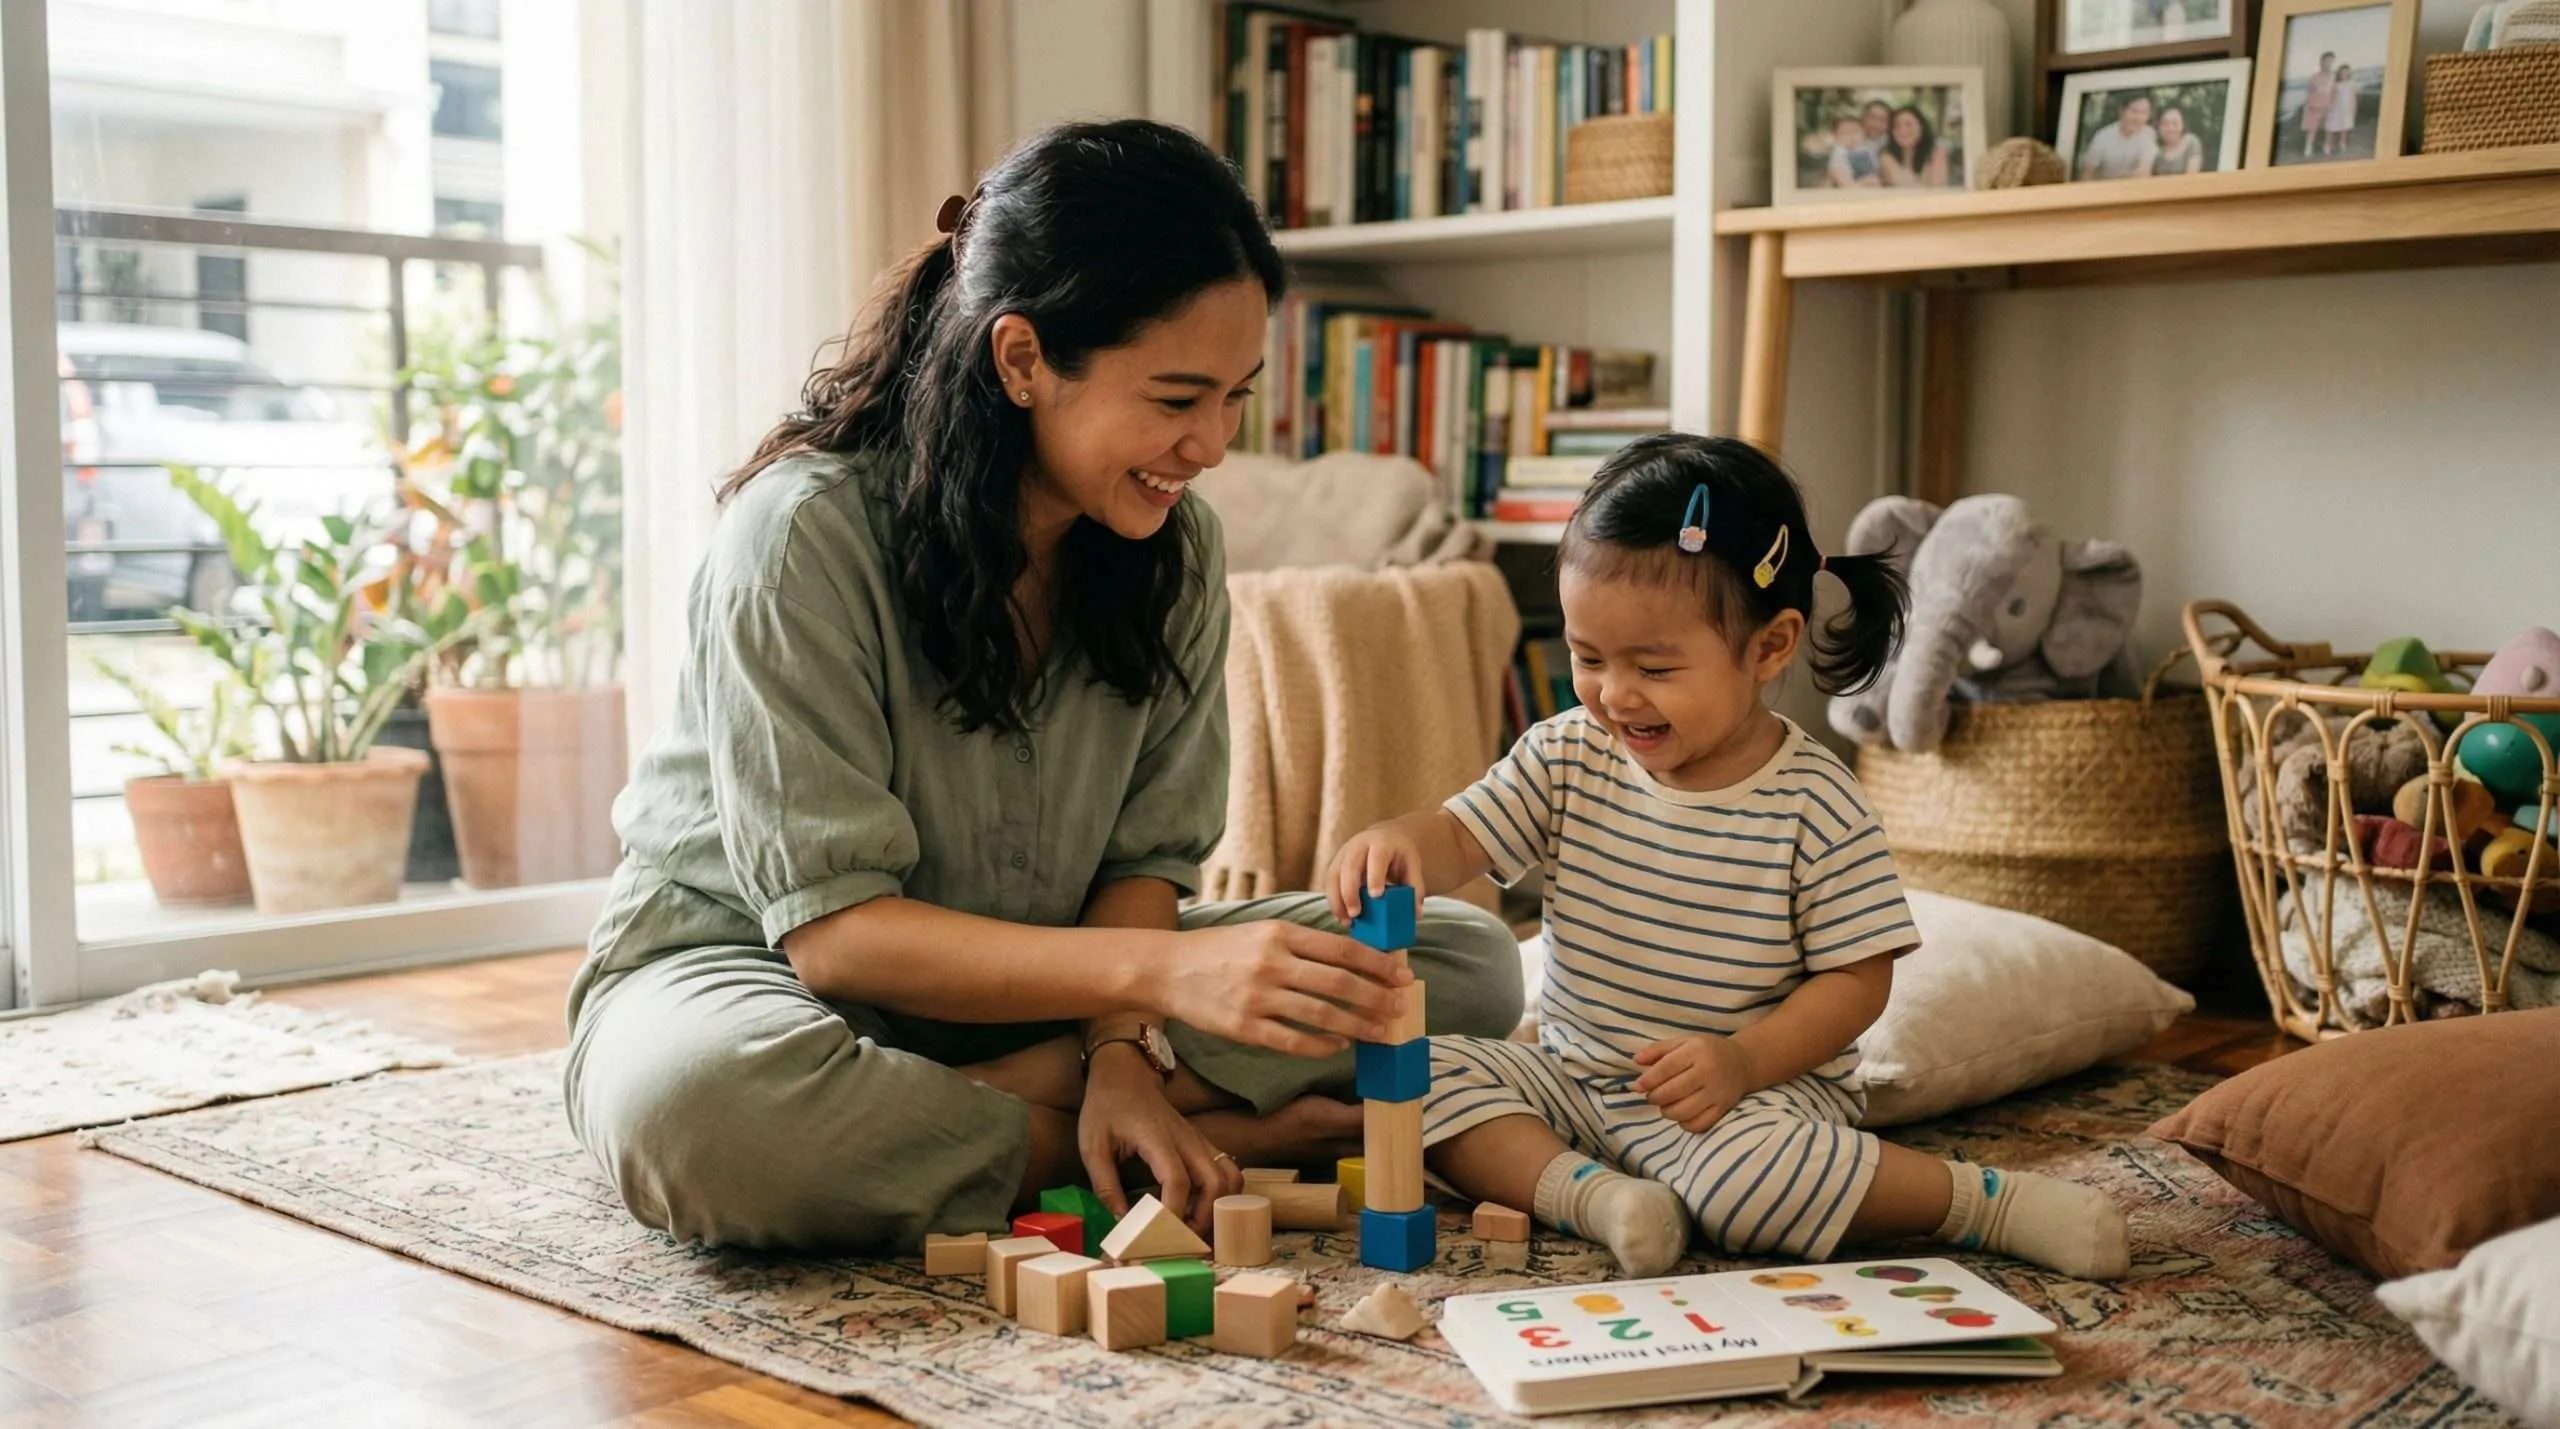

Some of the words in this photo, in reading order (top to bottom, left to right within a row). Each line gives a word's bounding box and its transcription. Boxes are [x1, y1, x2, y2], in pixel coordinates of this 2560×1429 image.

[1496, 1301, 1544, 1322] 5
[1598, 1318, 1654, 1341] 2
[1684, 1312, 1725, 1334] 1
[1518, 1326, 1572, 1349] 3
[1720, 1336, 1758, 1349] My
[1530, 1349, 1649, 1368] Numbers
[1655, 1343, 1714, 1356] First
